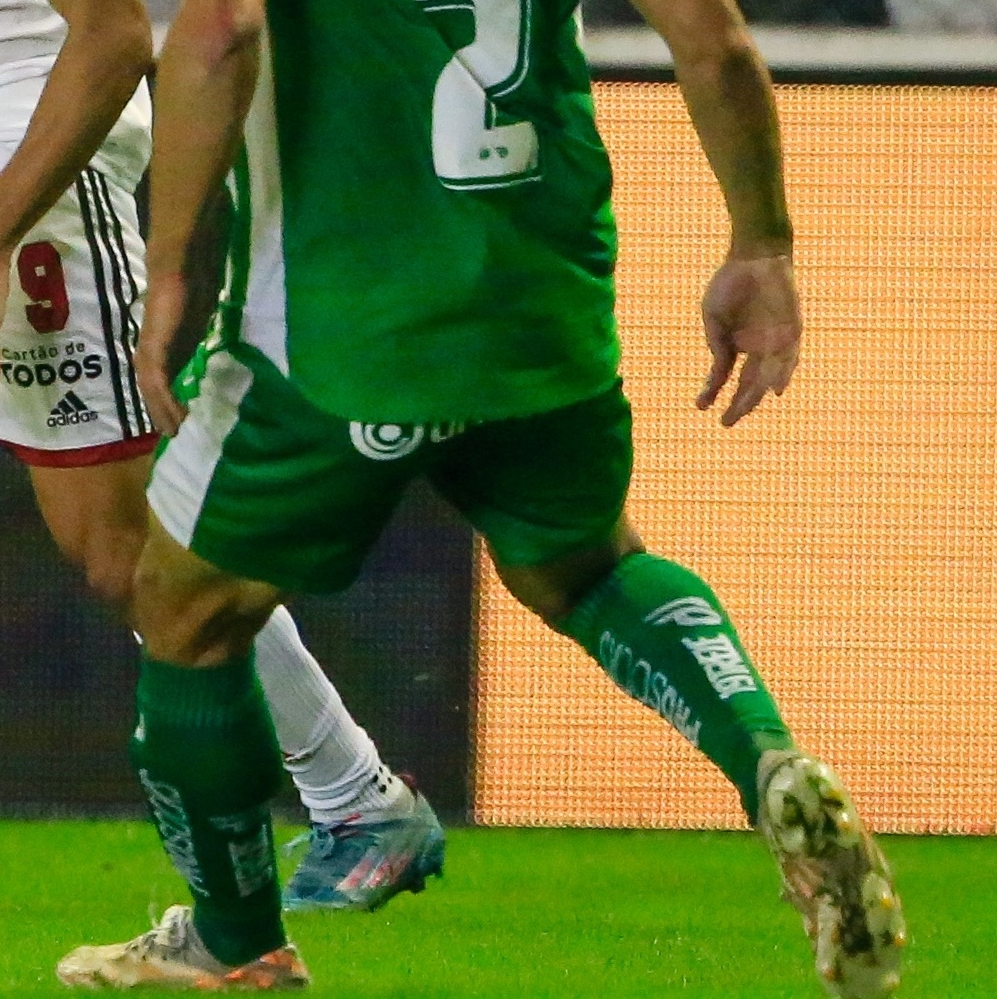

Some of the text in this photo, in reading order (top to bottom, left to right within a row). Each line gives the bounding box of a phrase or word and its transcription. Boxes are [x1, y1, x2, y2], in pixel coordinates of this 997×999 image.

[17, 241, 70, 334] 9
[2, 341, 85, 361] Cartão de
[0, 354, 103, 388] TODOS
[46, 410, 99, 428] adidas
